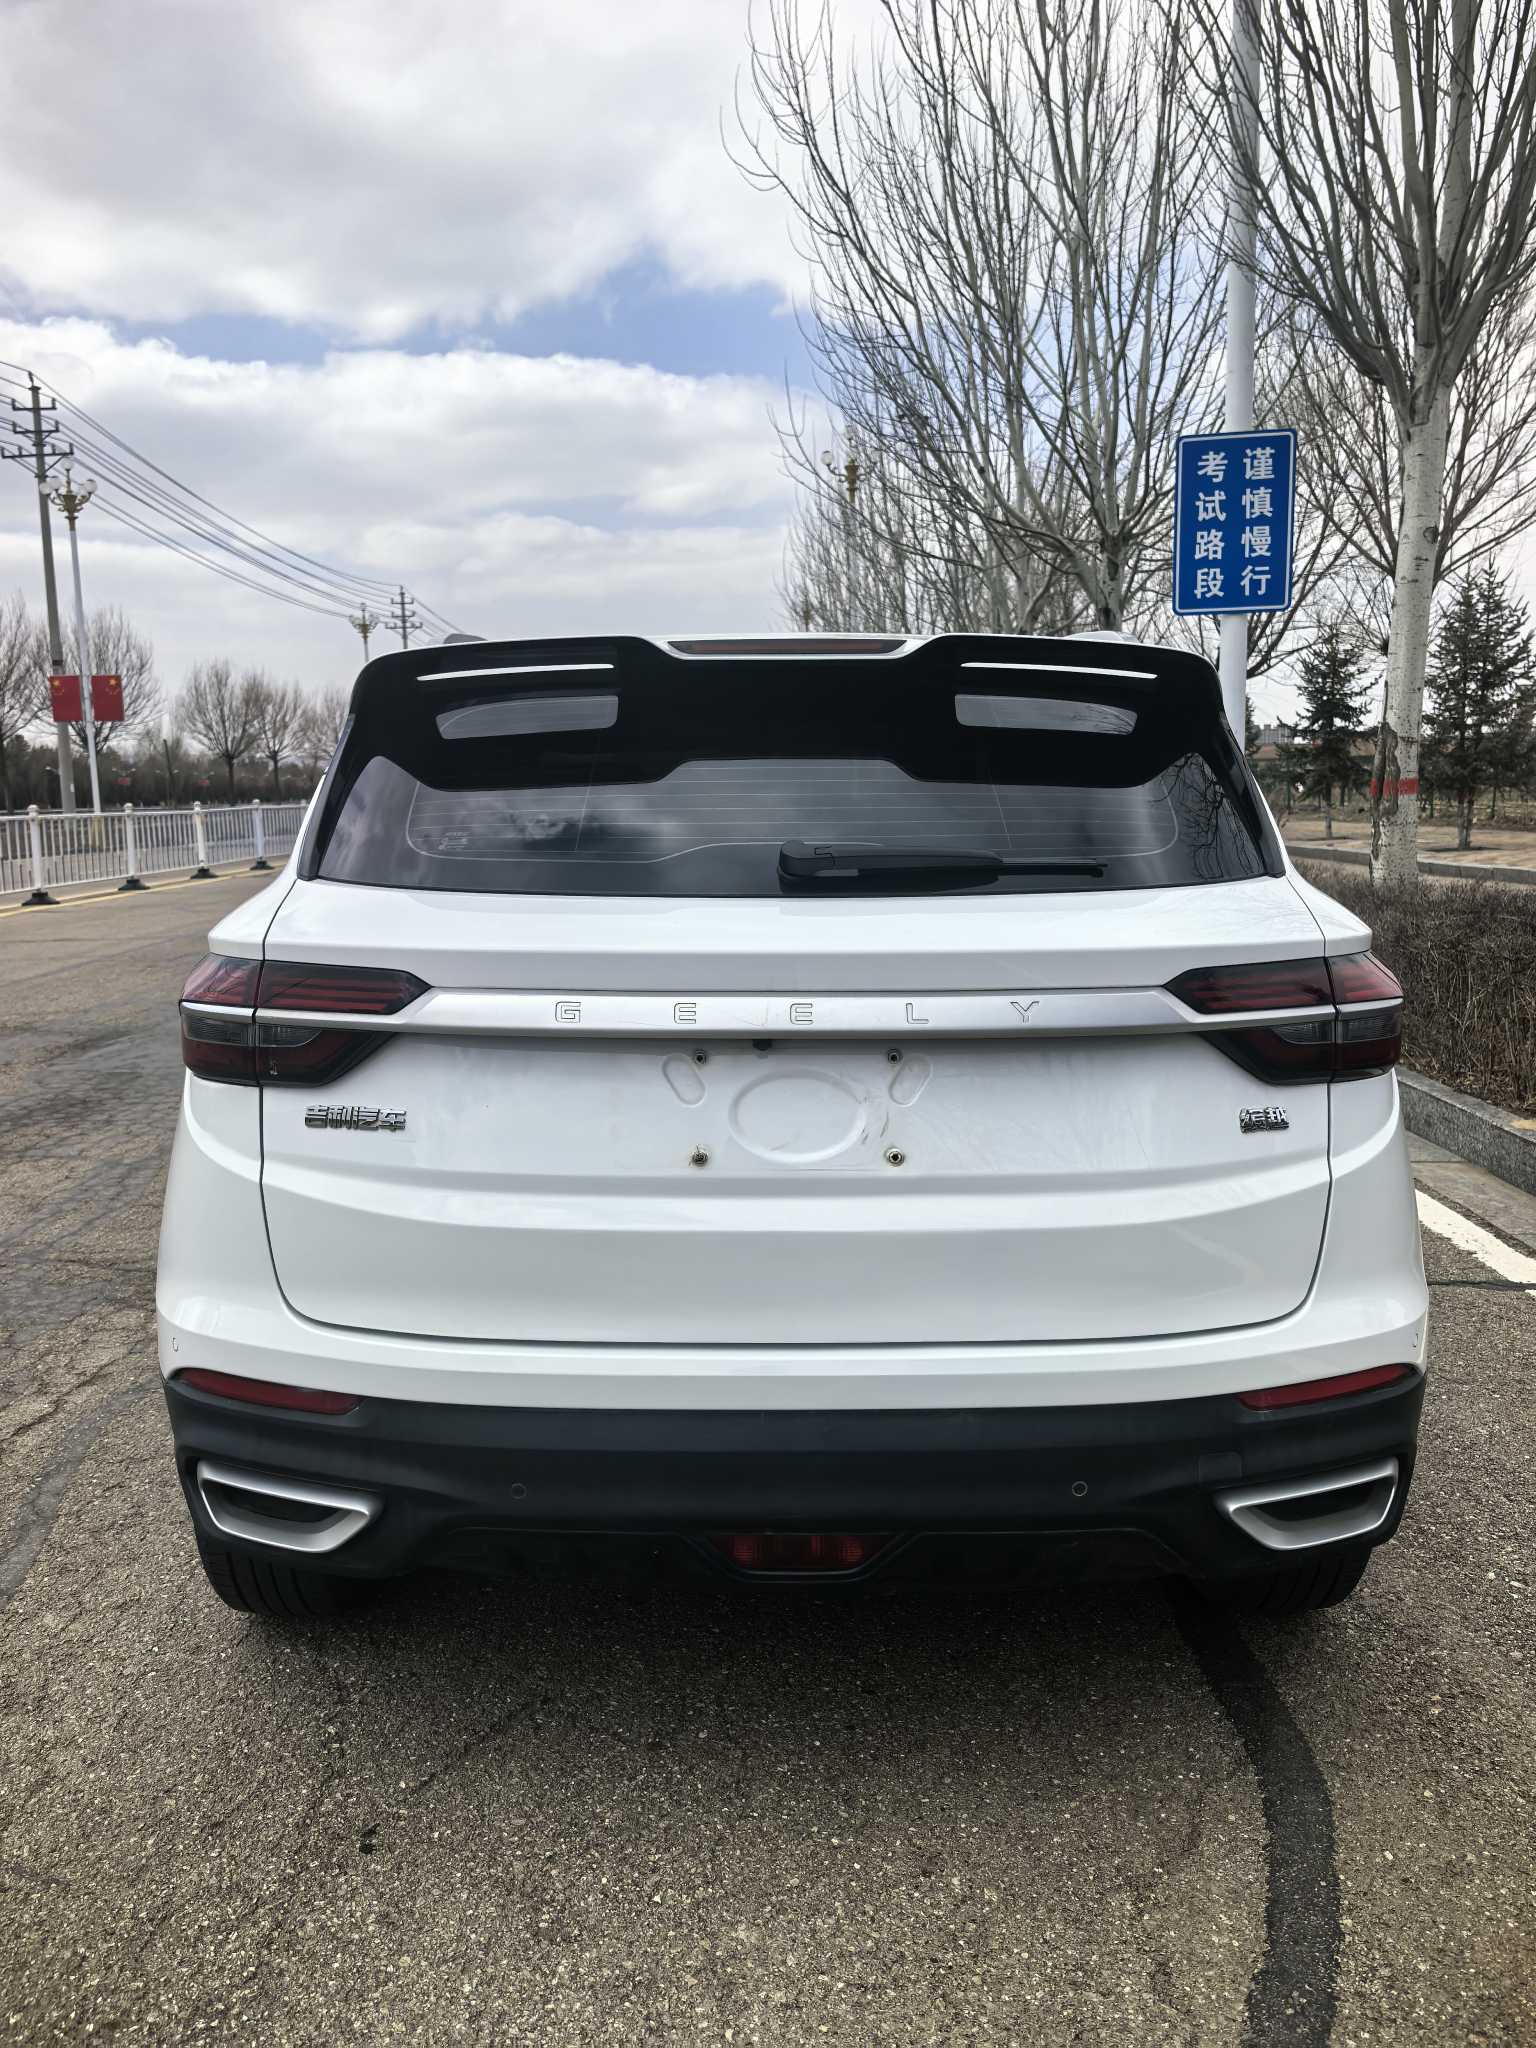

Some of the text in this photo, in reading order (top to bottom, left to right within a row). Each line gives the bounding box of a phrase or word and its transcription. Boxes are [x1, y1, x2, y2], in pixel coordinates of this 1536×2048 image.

[1194, 451, 1228, 599] 考试路段
[1240, 447, 1275, 597] 谨慎慢行
[555, 1001, 1040, 1024] GEELY
[304, 1104, 406, 1132] 吉利汽车
